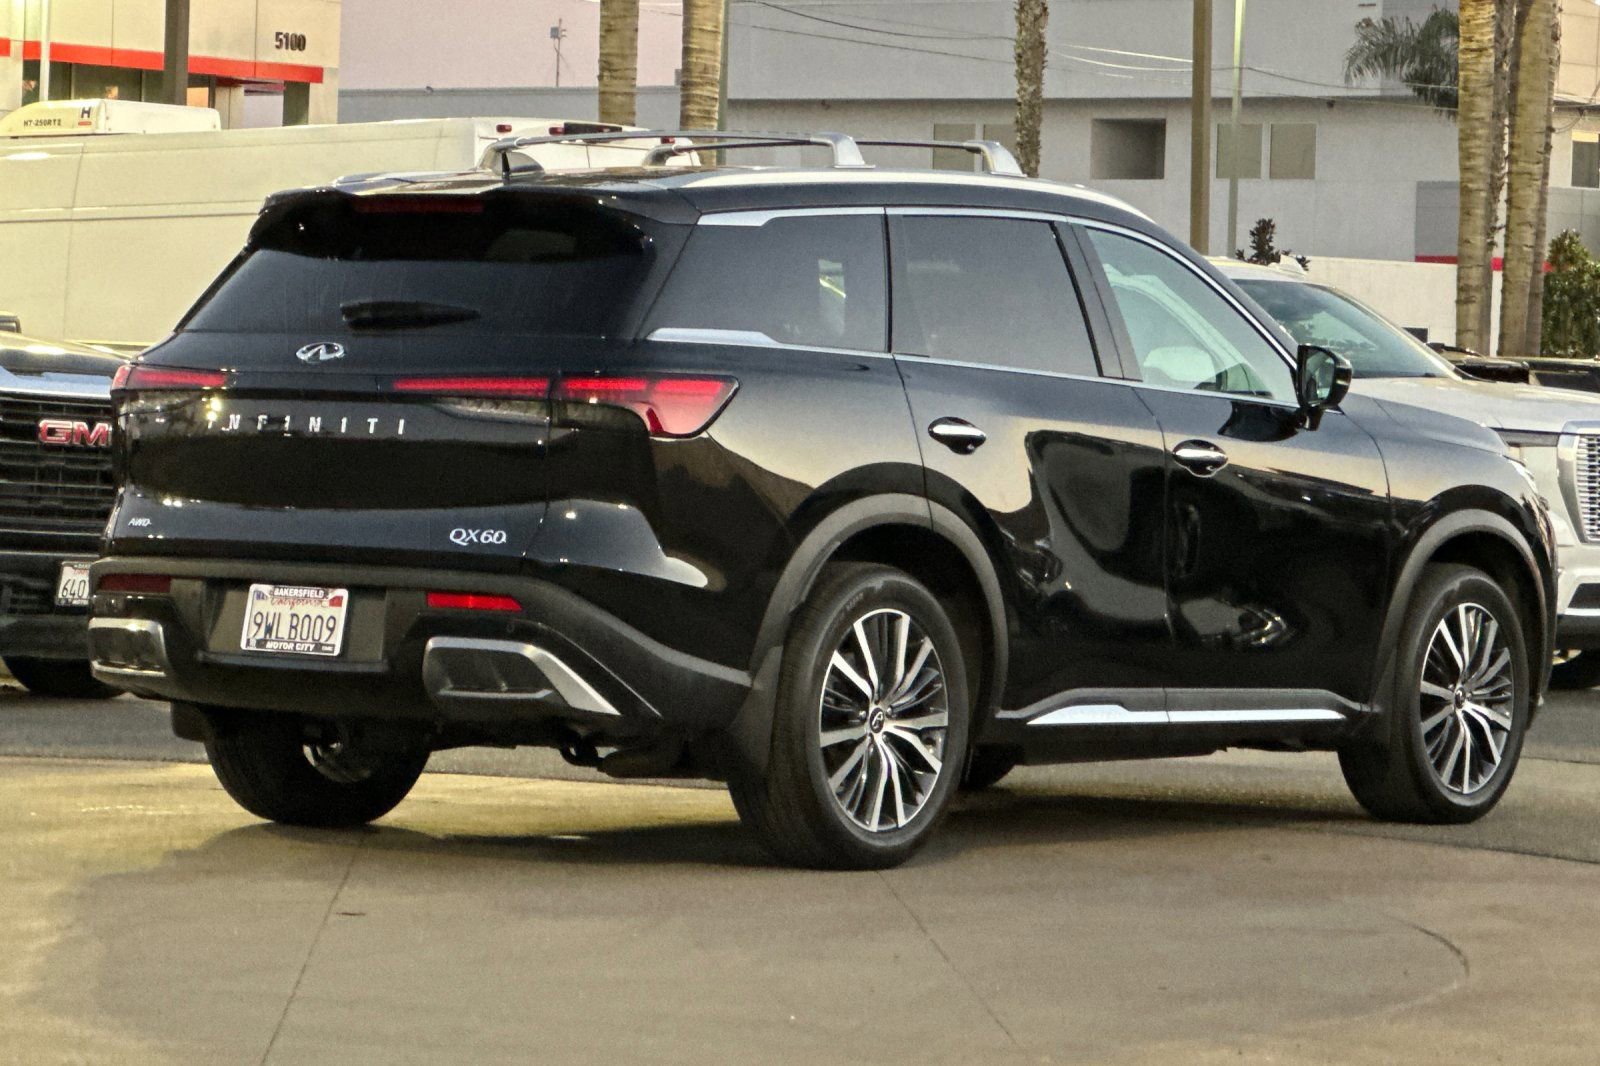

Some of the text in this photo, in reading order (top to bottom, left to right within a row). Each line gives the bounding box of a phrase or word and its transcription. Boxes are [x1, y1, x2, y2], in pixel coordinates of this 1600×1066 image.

[275, 31, 306, 51] 5100
[128, 518, 152, 527] AWD
[449, 528, 507, 546] QX60
[61, 578, 86, 598] 640
[273, 587, 325, 598] BAKERSFIELD
[252, 611, 337, 642] 9WLB009
[265, 641, 294, 650] MOTOR
[295, 643, 316, 652] CITY
